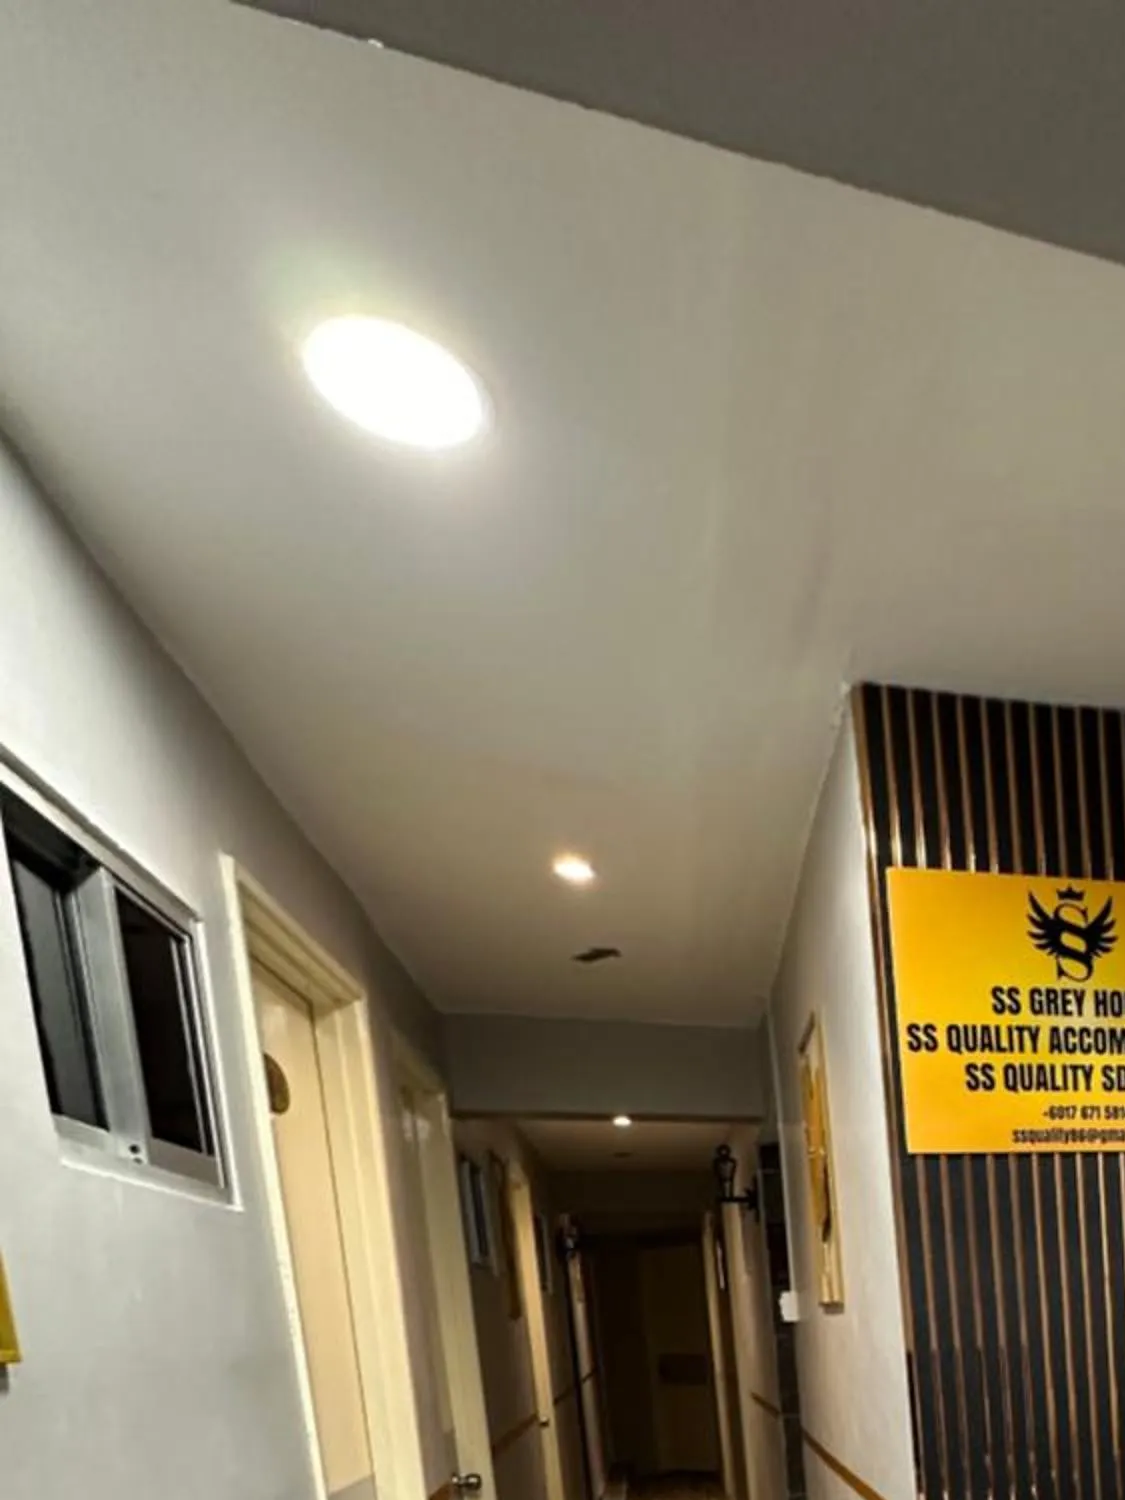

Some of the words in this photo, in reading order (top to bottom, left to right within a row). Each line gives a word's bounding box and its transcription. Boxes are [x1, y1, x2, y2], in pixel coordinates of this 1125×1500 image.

[991, 987, 1021, 1014] SS
[1030, 988, 1086, 1016] GREY
[907, 1024, 937, 1052] SS
[947, 1025, 1040, 1055] QUALITY
[965, 1063, 995, 1091] SS
[1004, 1064, 1094, 1093] QUALITY
